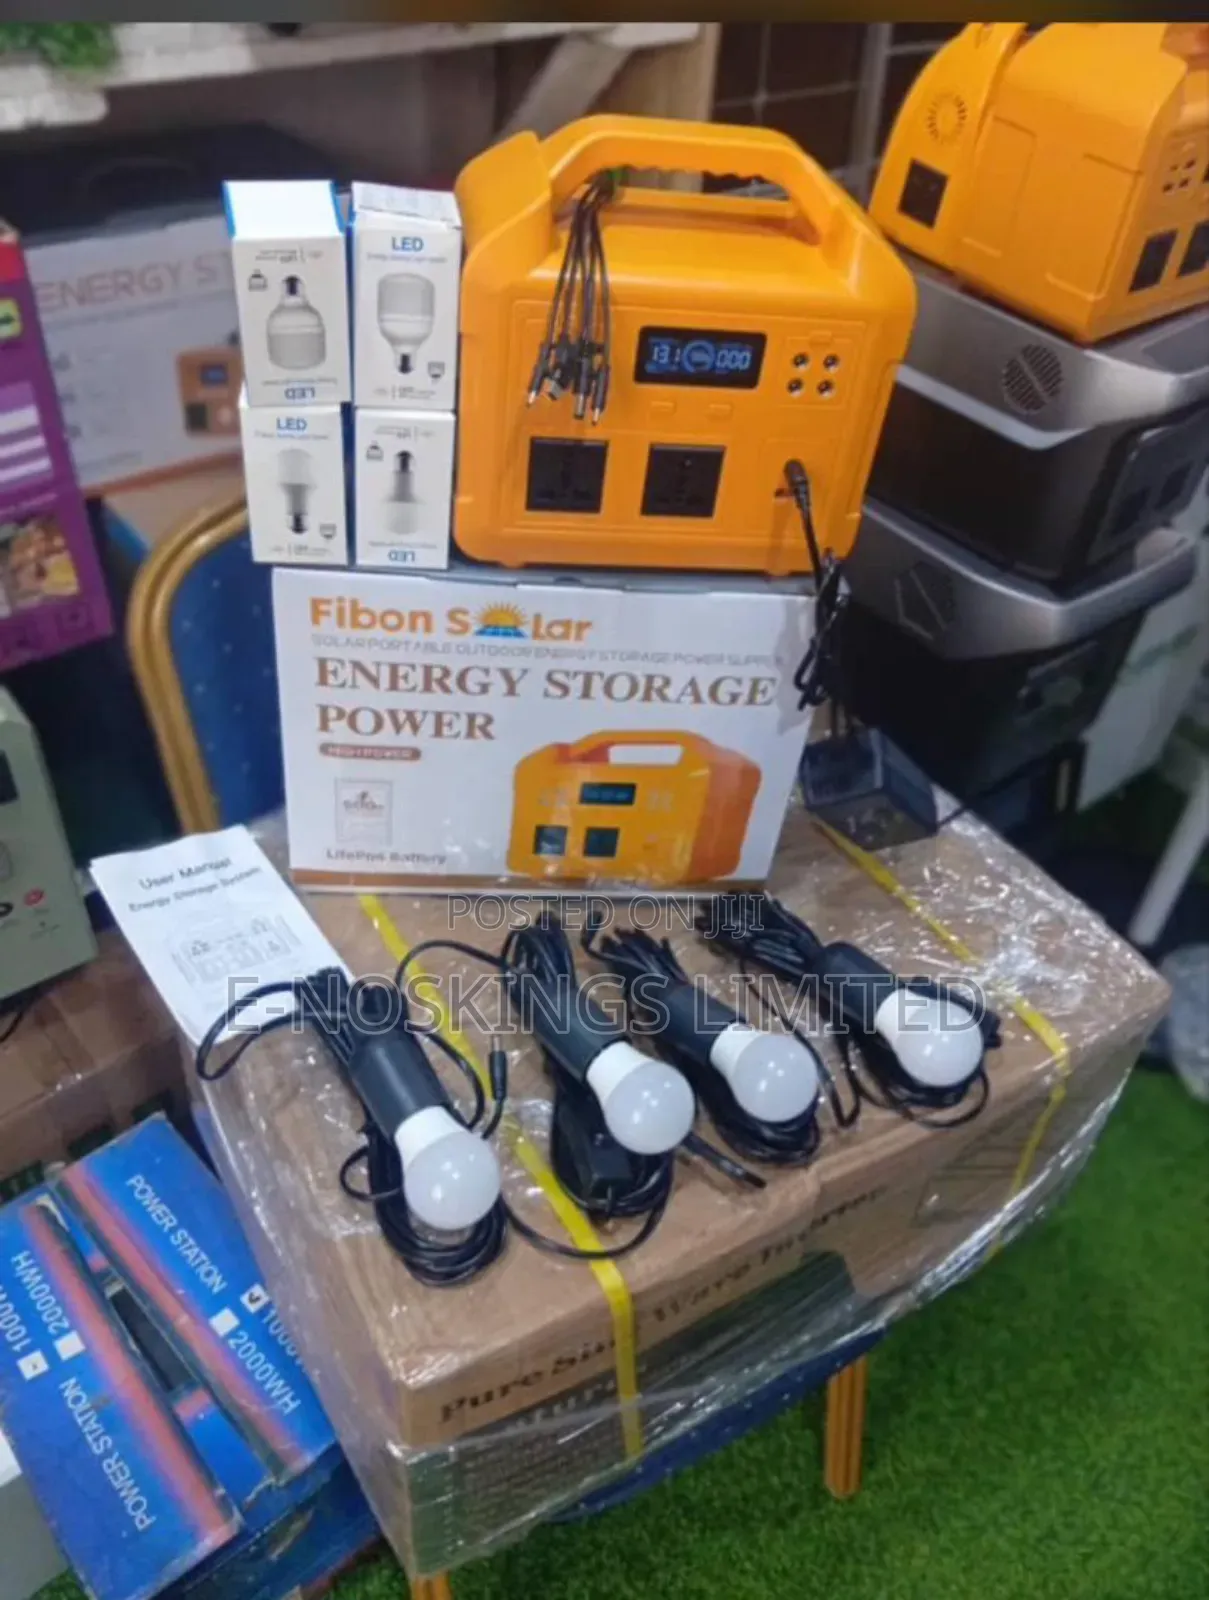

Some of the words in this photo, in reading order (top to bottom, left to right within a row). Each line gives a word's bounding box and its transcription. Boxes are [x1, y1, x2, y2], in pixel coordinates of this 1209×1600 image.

[391, 236, 424, 252] LED
[284, 387, 315, 399] LED
[276, 417, 308, 431] LED
[388, 550, 415, 562] LED
[309, 597, 434, 635] Fibon
[313, 657, 530, 698] ENERGY
[543, 668, 777, 707] STORAGE
[315, 704, 496, 741] POWER
[138, 872, 174, 890] User
[178, 857, 231, 879] Manual
[126, 1174, 178, 1232] POWER
[170, 1229, 228, 1294] STATION
[11, 1250, 70, 1336] 2000WH
[227, 1330, 302, 1416] 2000WH
[59, 1376, 113, 1456] STATION
[440, 1370, 544, 1424] Pure
[103, 1451, 157, 1531] POWER
